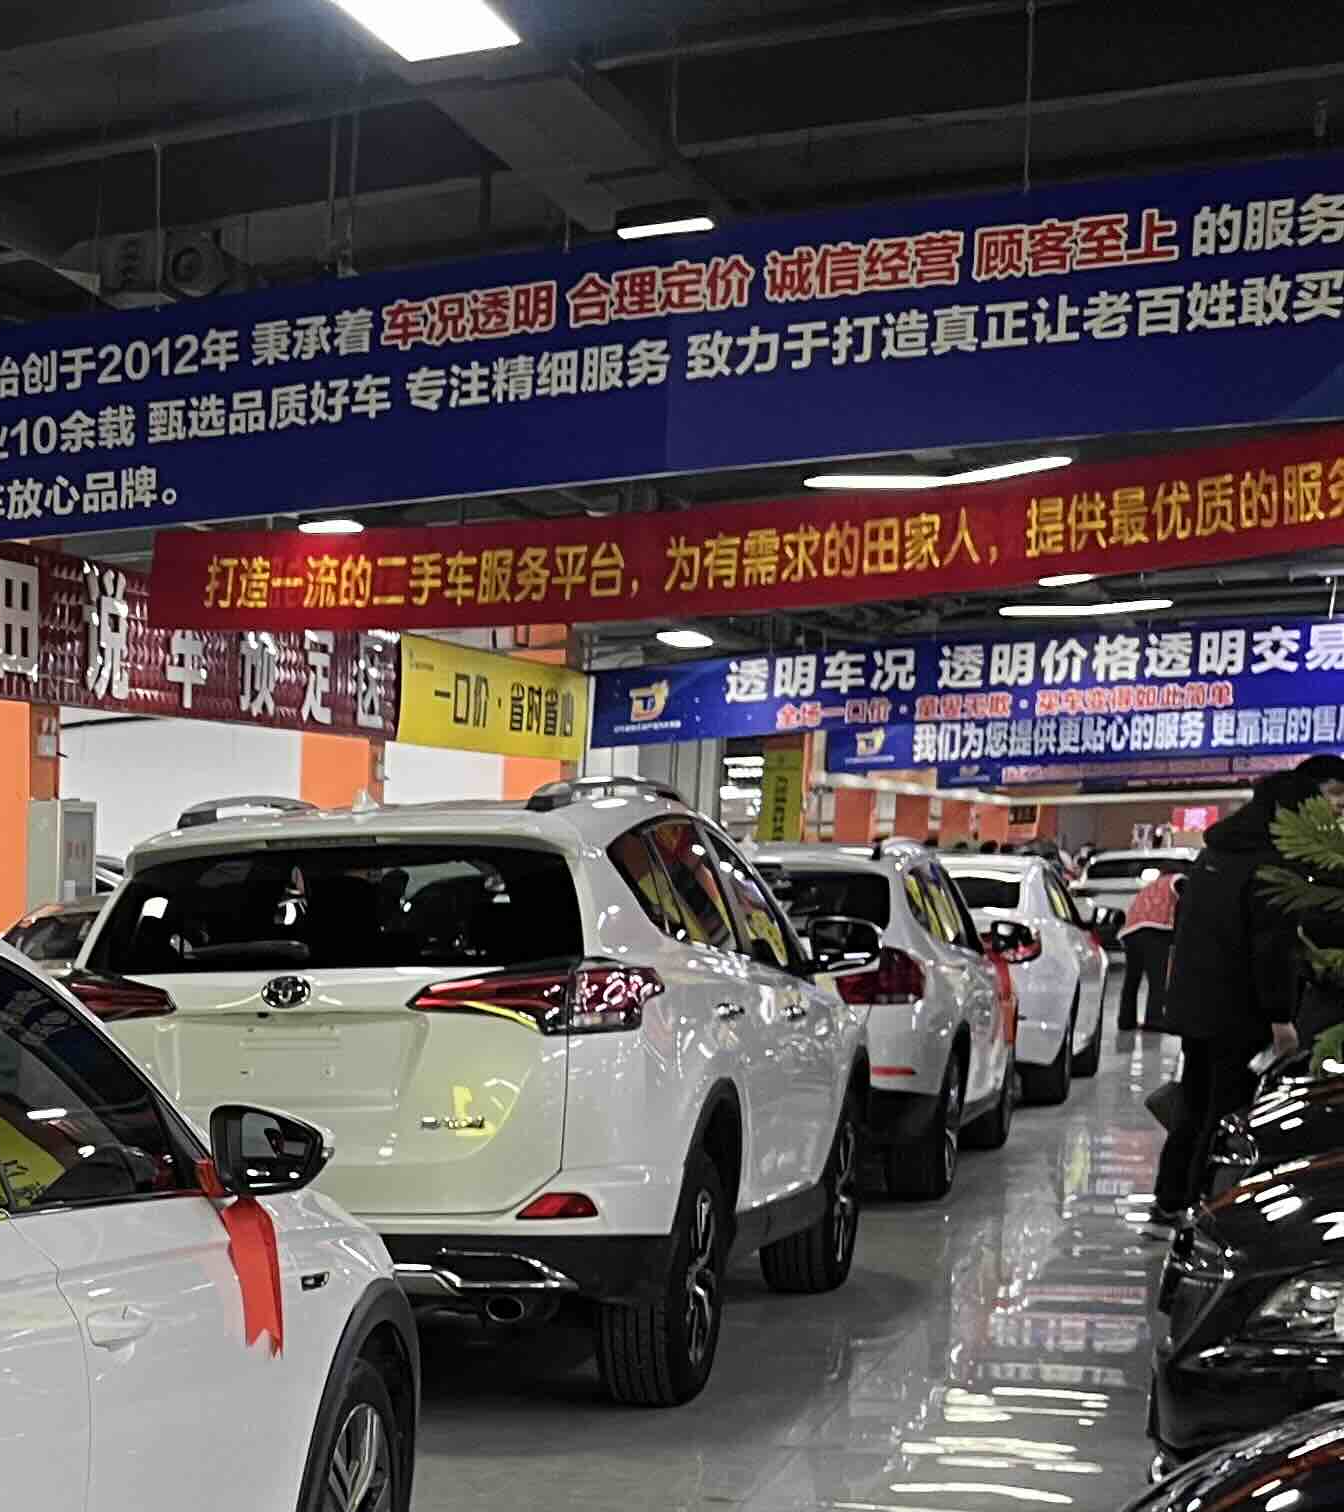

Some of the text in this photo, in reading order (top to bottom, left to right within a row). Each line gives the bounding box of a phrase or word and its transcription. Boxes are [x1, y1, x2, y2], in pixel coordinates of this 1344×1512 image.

[251, 309, 375, 363] 秉承着
[382, 281, 557, 350] 车况透明
[567, 260, 753, 329] 合理定价
[764, 231, 963, 304] 诚信经营
[973, 208, 1180, 281] 顾客至上
[148, 373, 392, 445] 甄选品质好车
[405, 340, 672, 412] 专注精细服务
[685, 271, 1344, 380] 致力于打造真正让老百姓敢买
[725, 623, 1344, 703] 透明车况 透明价格透明交易
[913, 704, 1344, 763] 我们为您提供更贴心的服务 更靠谱的售
